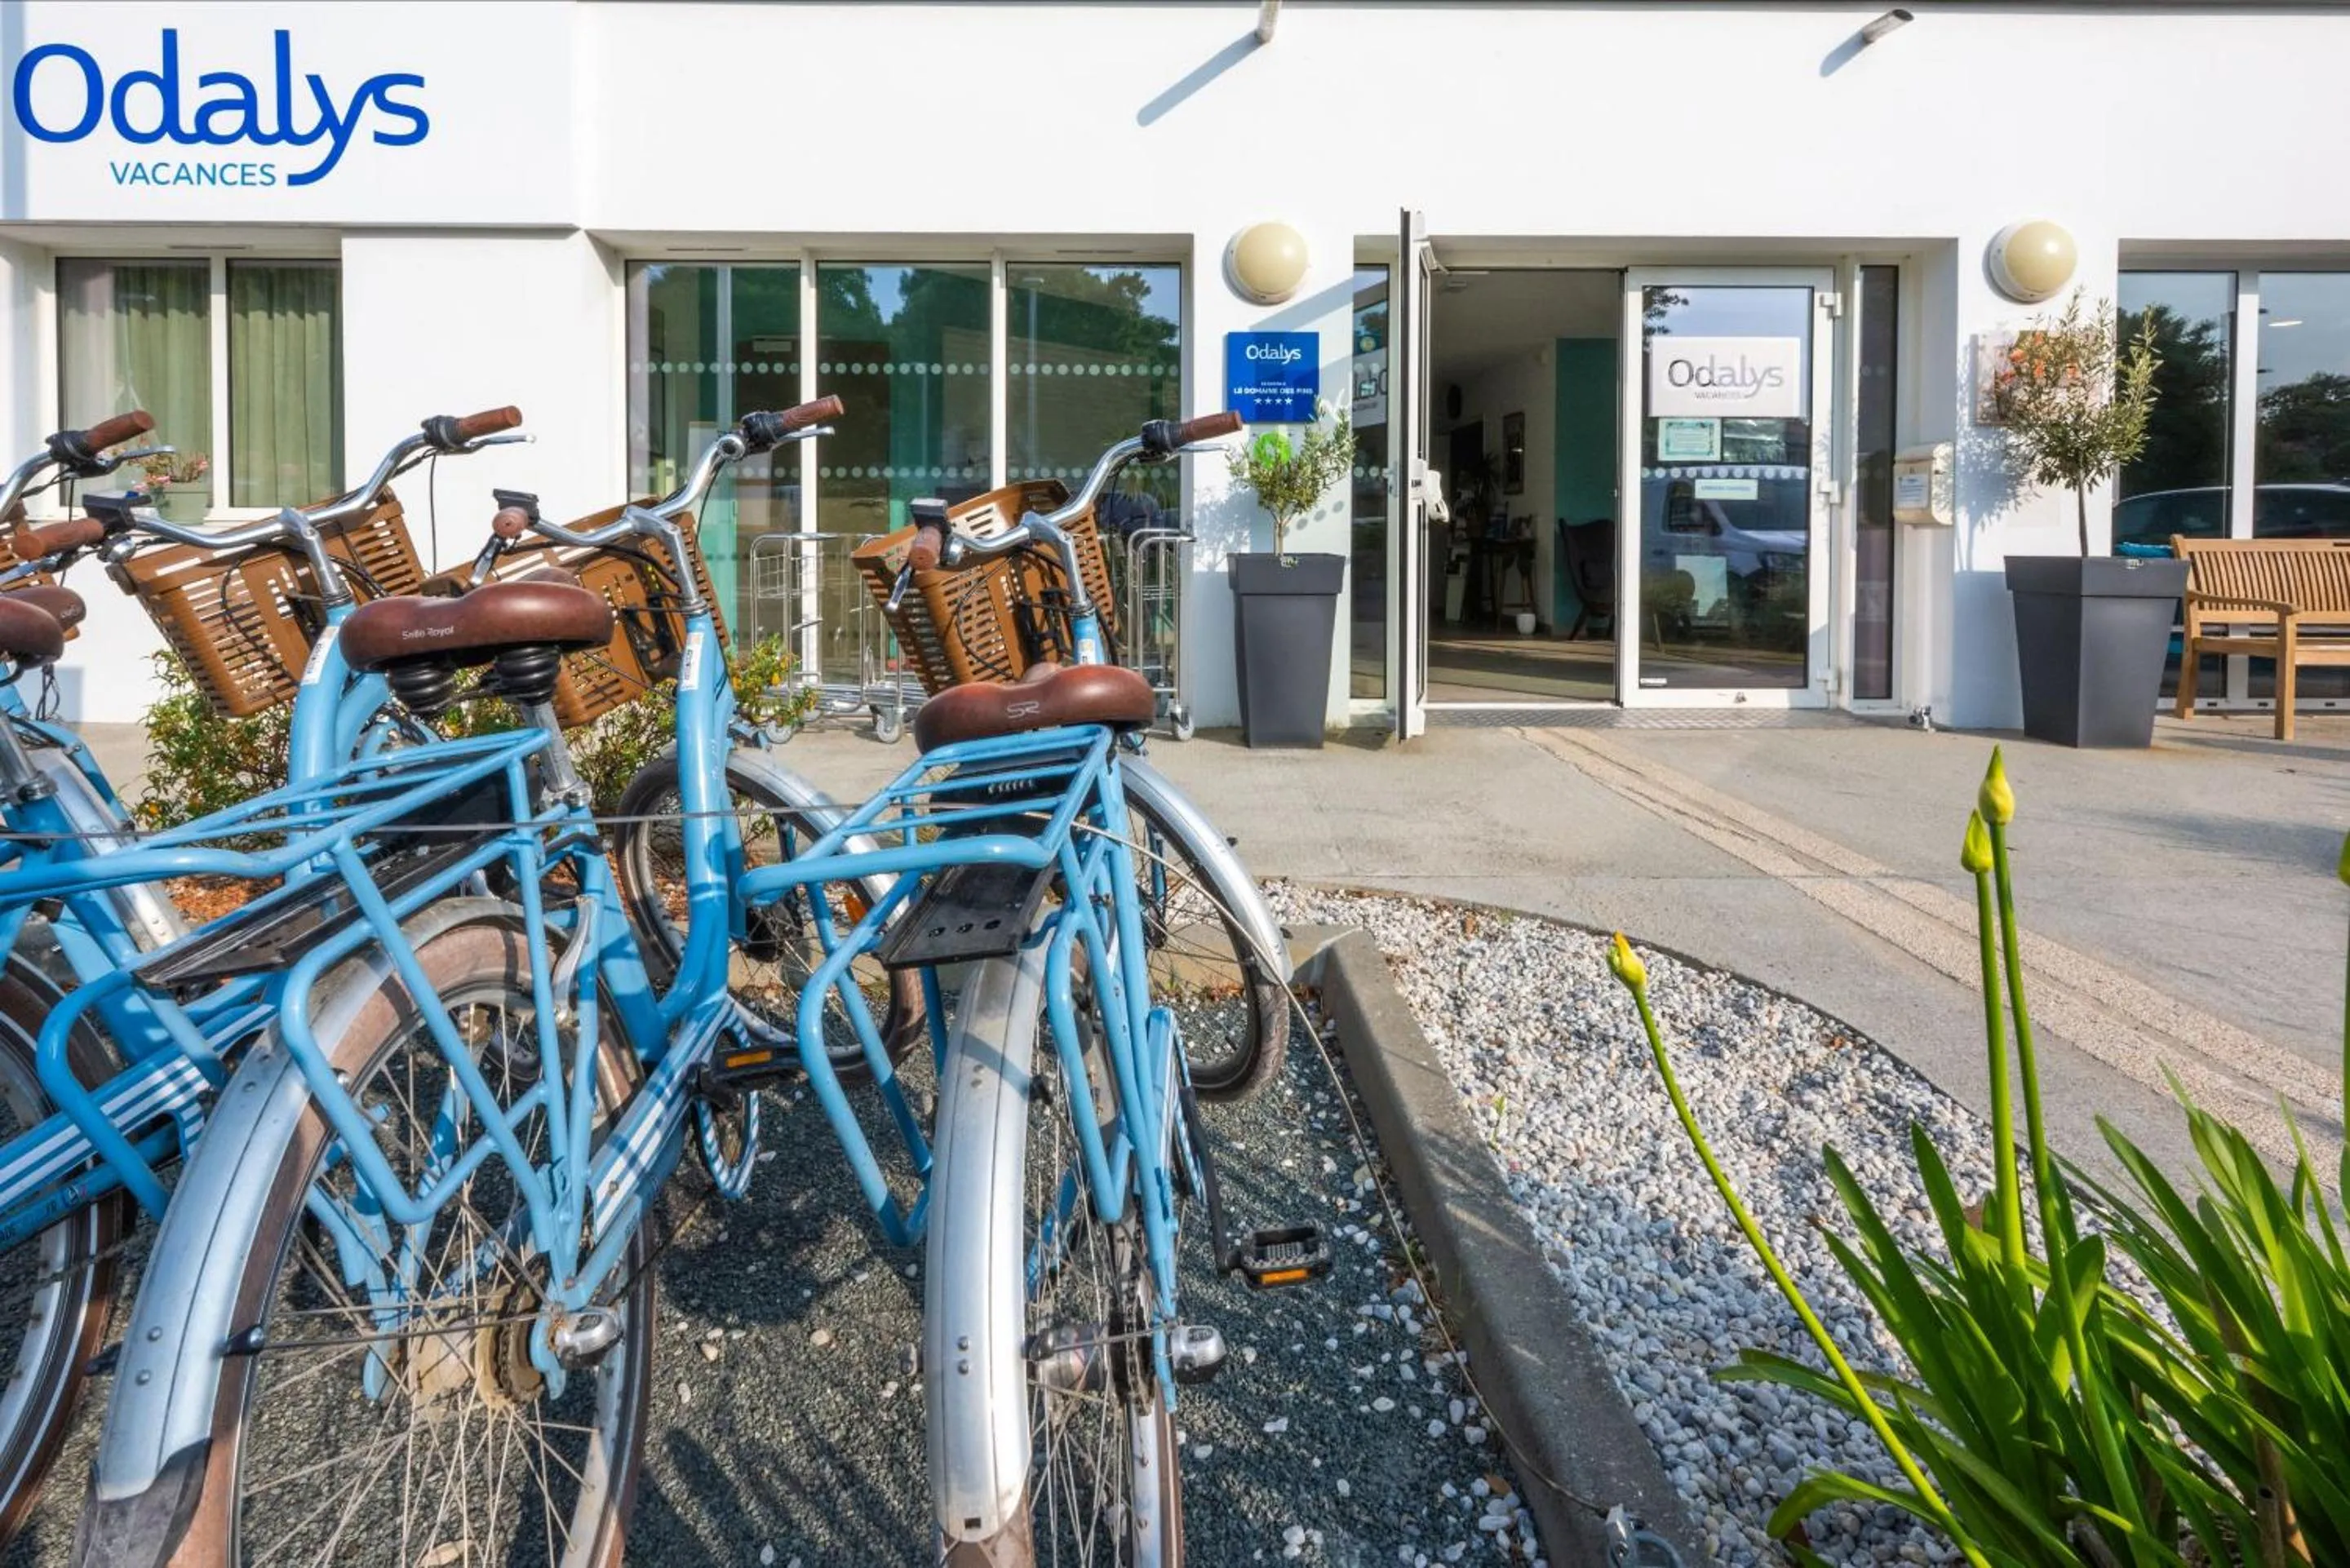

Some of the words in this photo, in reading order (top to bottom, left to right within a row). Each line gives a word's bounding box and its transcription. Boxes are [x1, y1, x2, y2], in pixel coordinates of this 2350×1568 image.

[12, 28, 430, 186] Odalys
[110, 162, 276, 186] VACANCES
[1245, 343, 1302, 365] Odalys
[1668, 354, 1785, 399] Odalys
